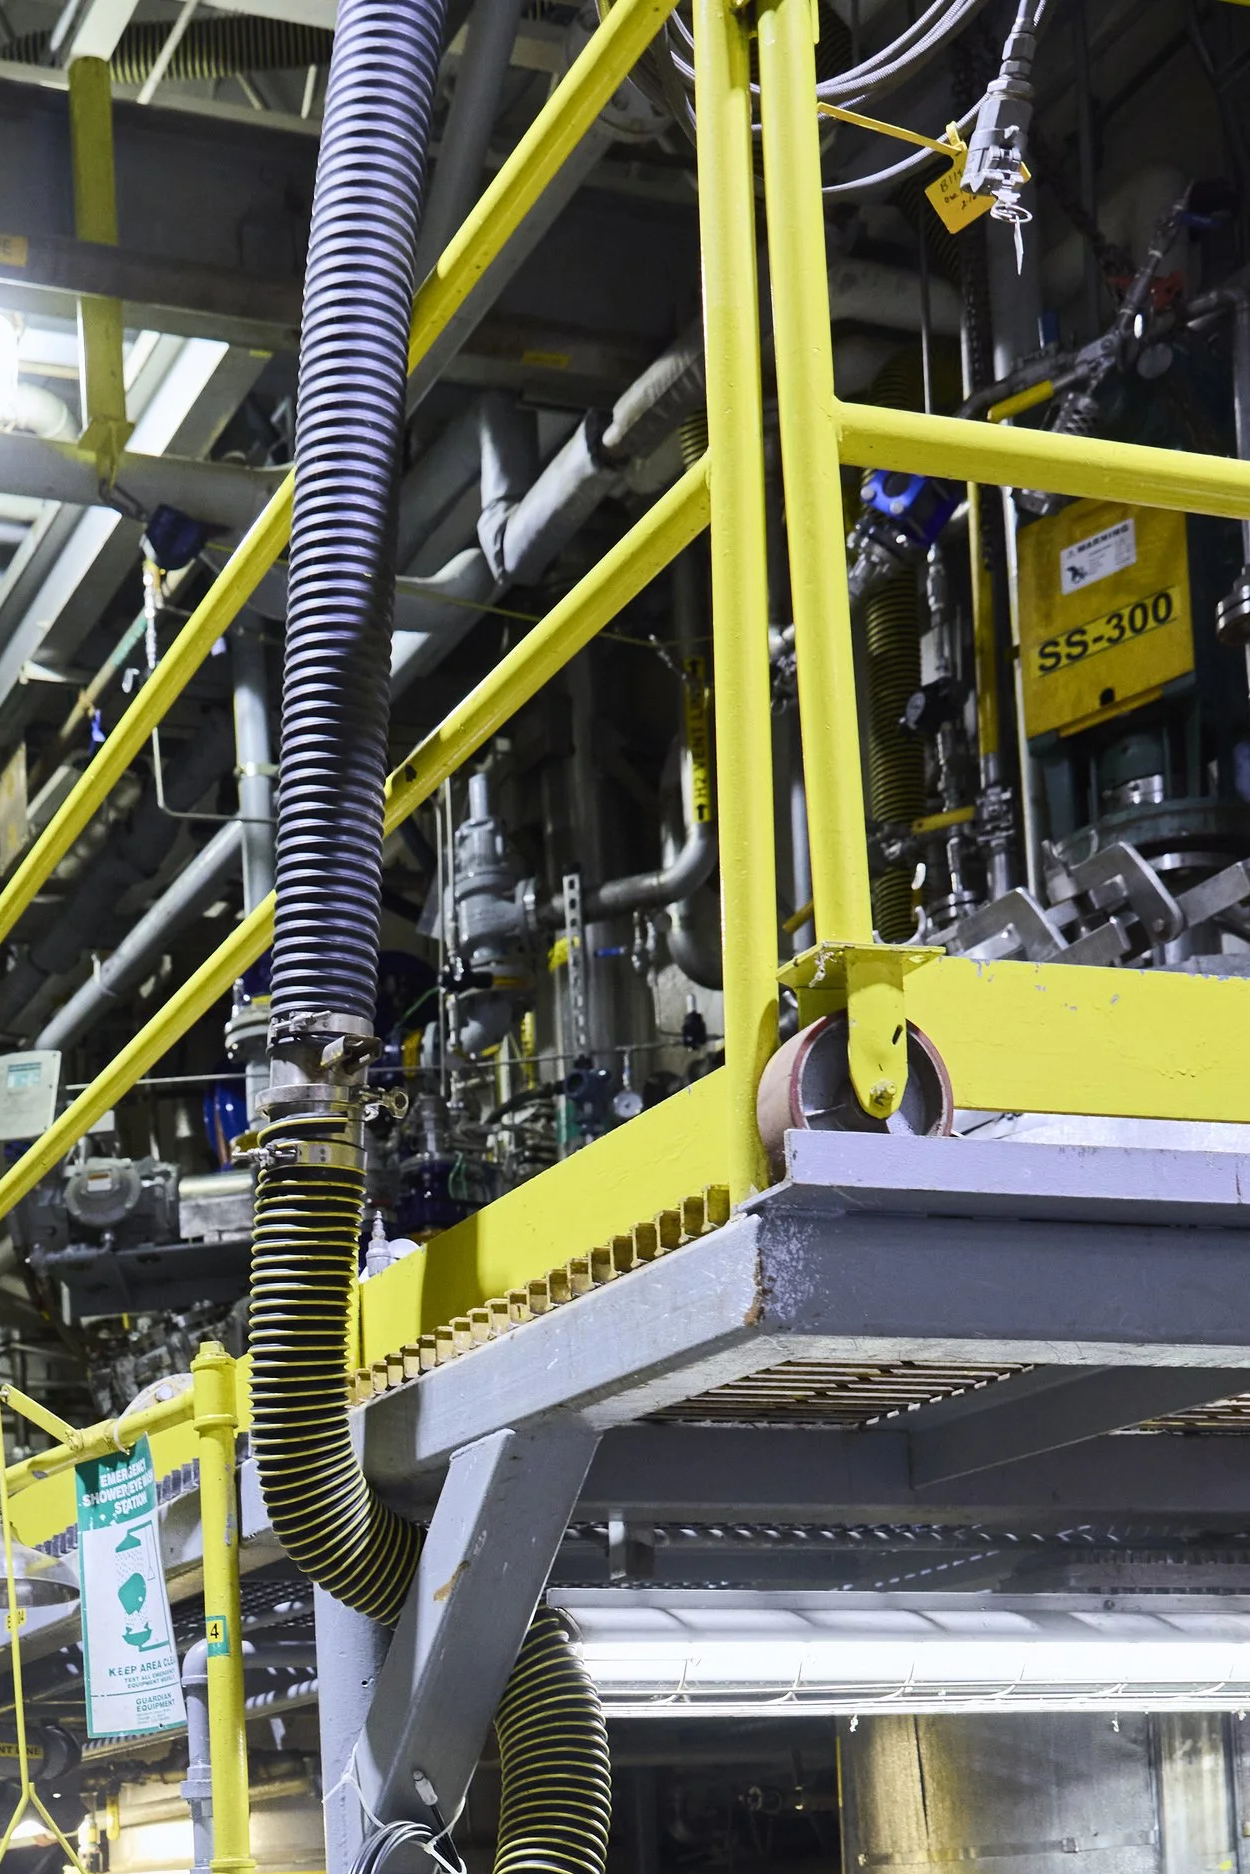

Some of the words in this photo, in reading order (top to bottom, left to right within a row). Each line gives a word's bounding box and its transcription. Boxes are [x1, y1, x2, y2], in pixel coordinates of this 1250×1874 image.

[1077, 524, 1129, 553] WARNING
[1038, 592, 1172, 672] SS-300
[210, 1623, 219, 1639] 4
[109, 1665, 137, 1677] KEEP
[140, 1659, 162, 1672] AREA
[136, 1692, 172, 1705] GUARDIAN
[137, 1699, 175, 1713] EQUIPMENT
[15, 1747, 41, 1755] LNE
